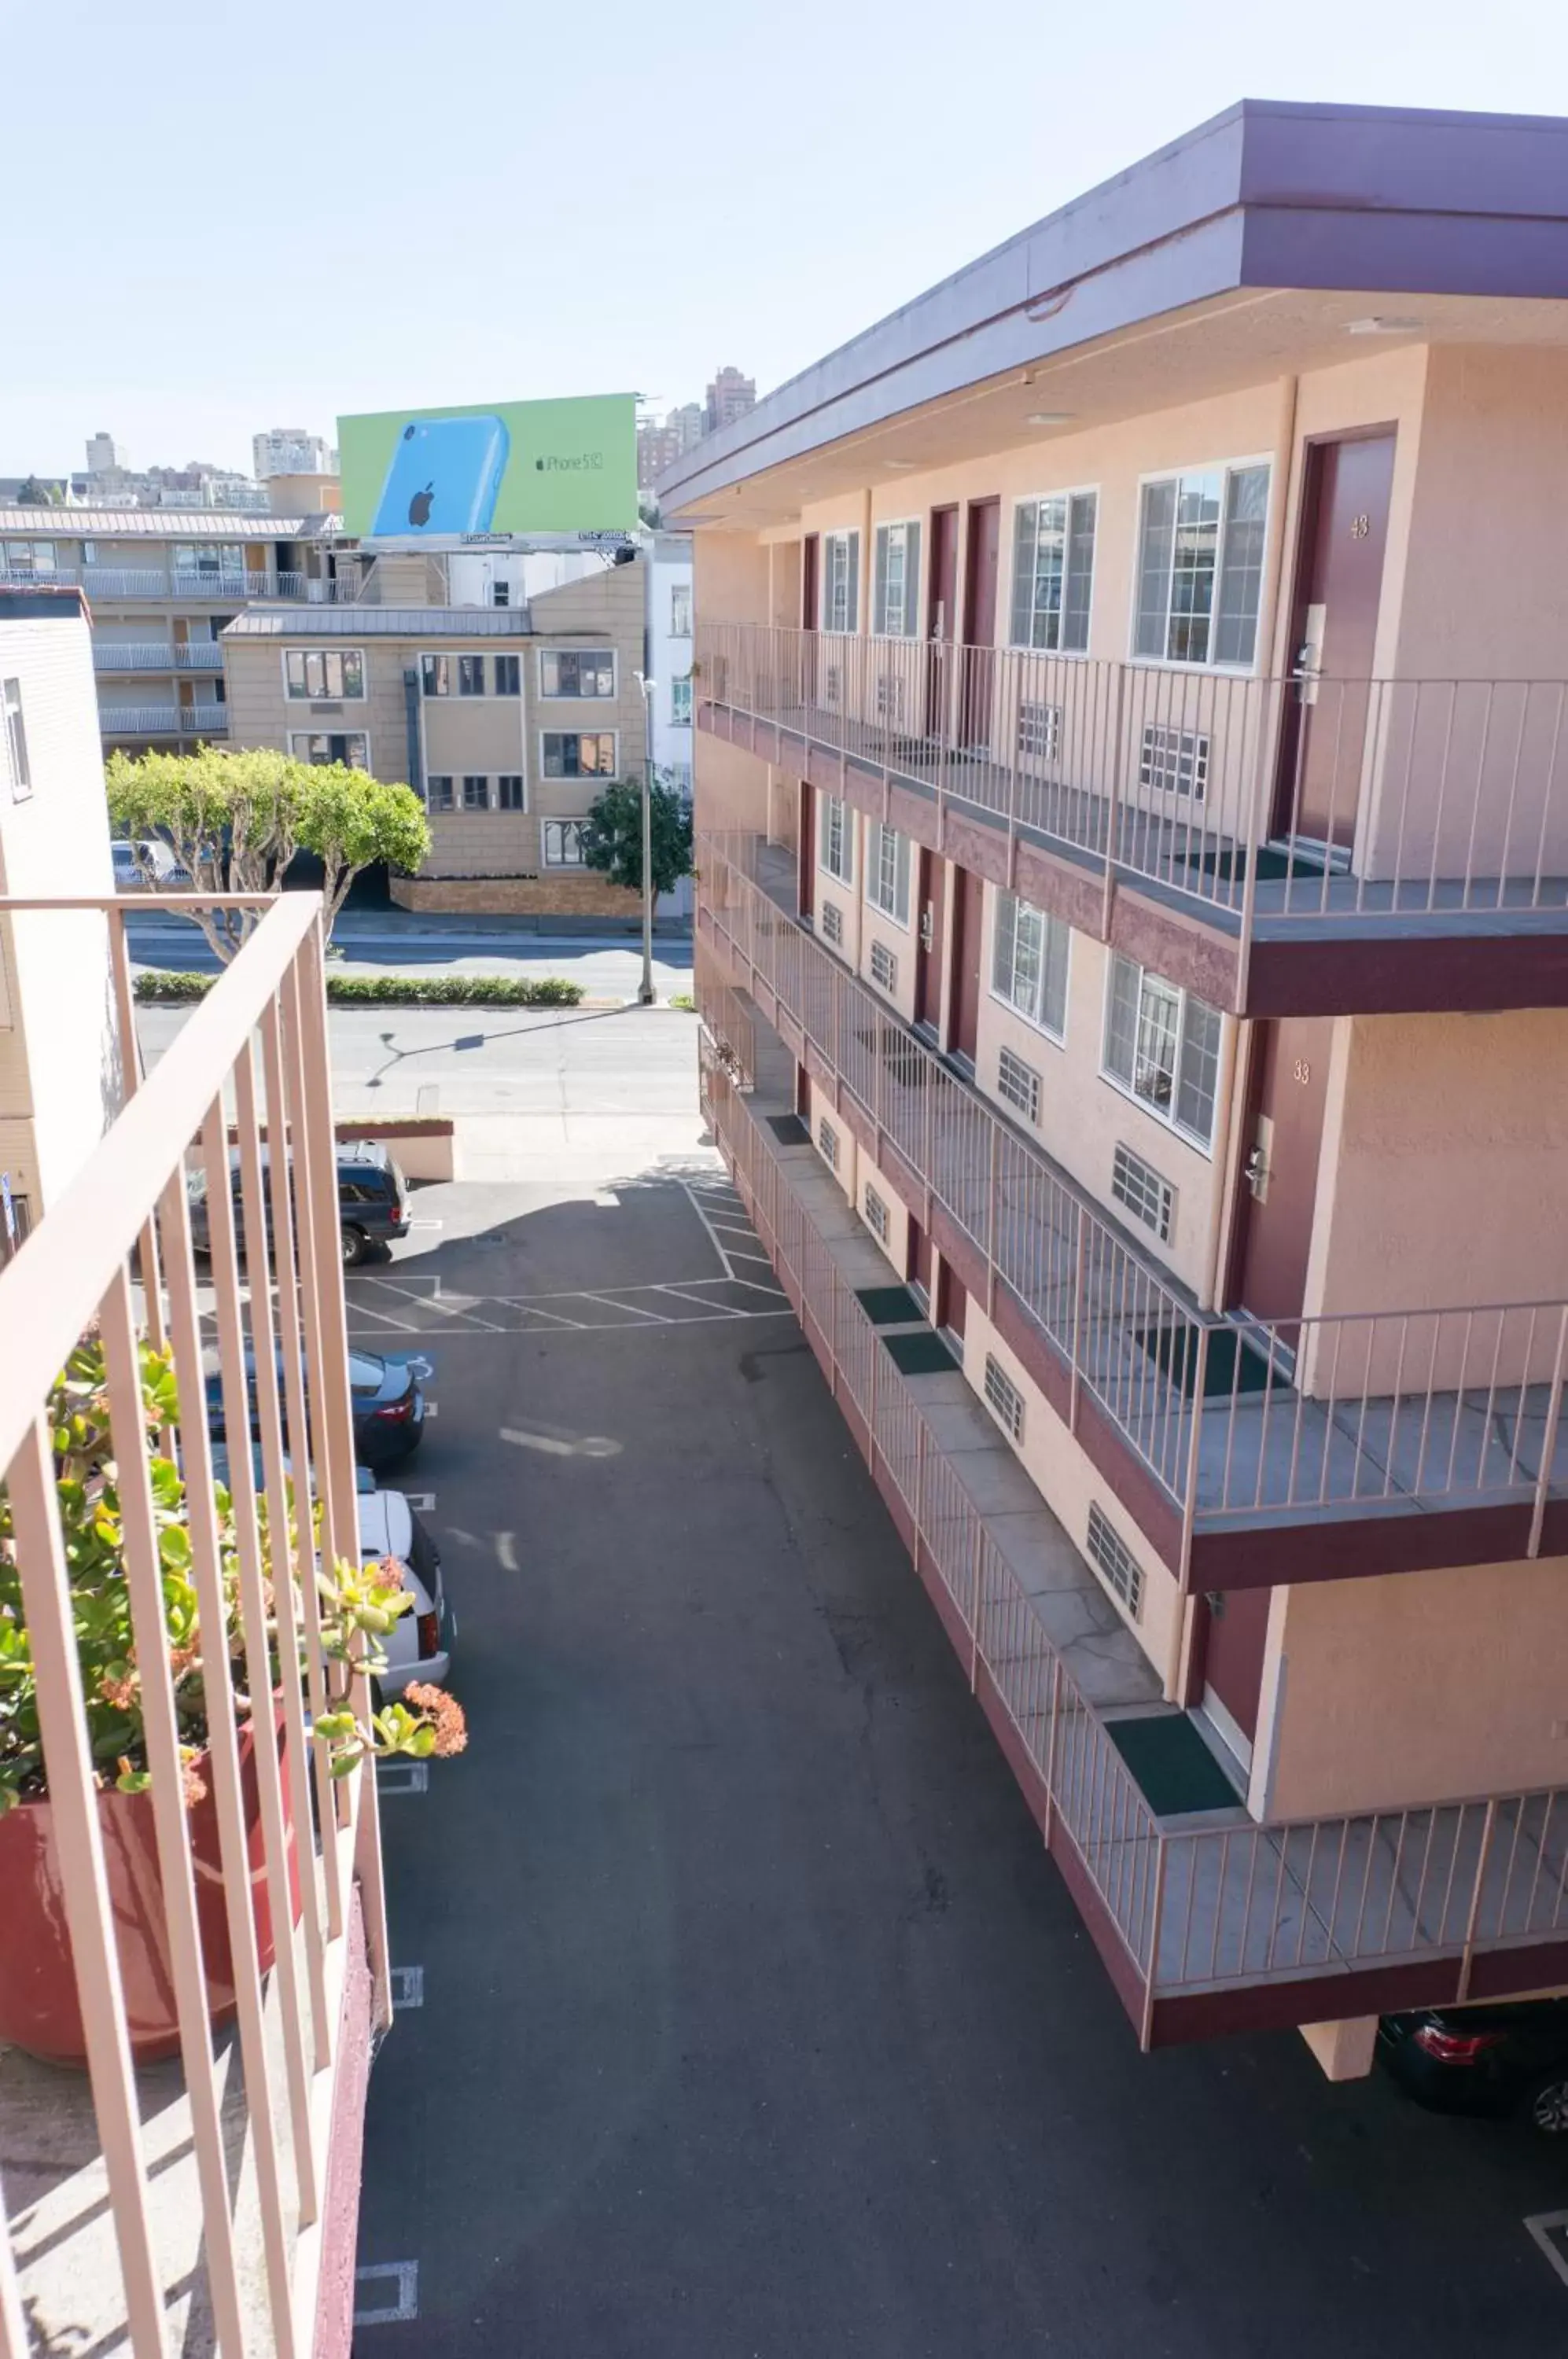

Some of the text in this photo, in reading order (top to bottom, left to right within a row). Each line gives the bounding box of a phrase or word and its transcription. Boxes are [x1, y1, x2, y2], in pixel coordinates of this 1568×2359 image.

[547, 455, 583, 471] iPhone
[1350, 514, 1368, 539] 43
[1294, 1059, 1310, 1084] 33
